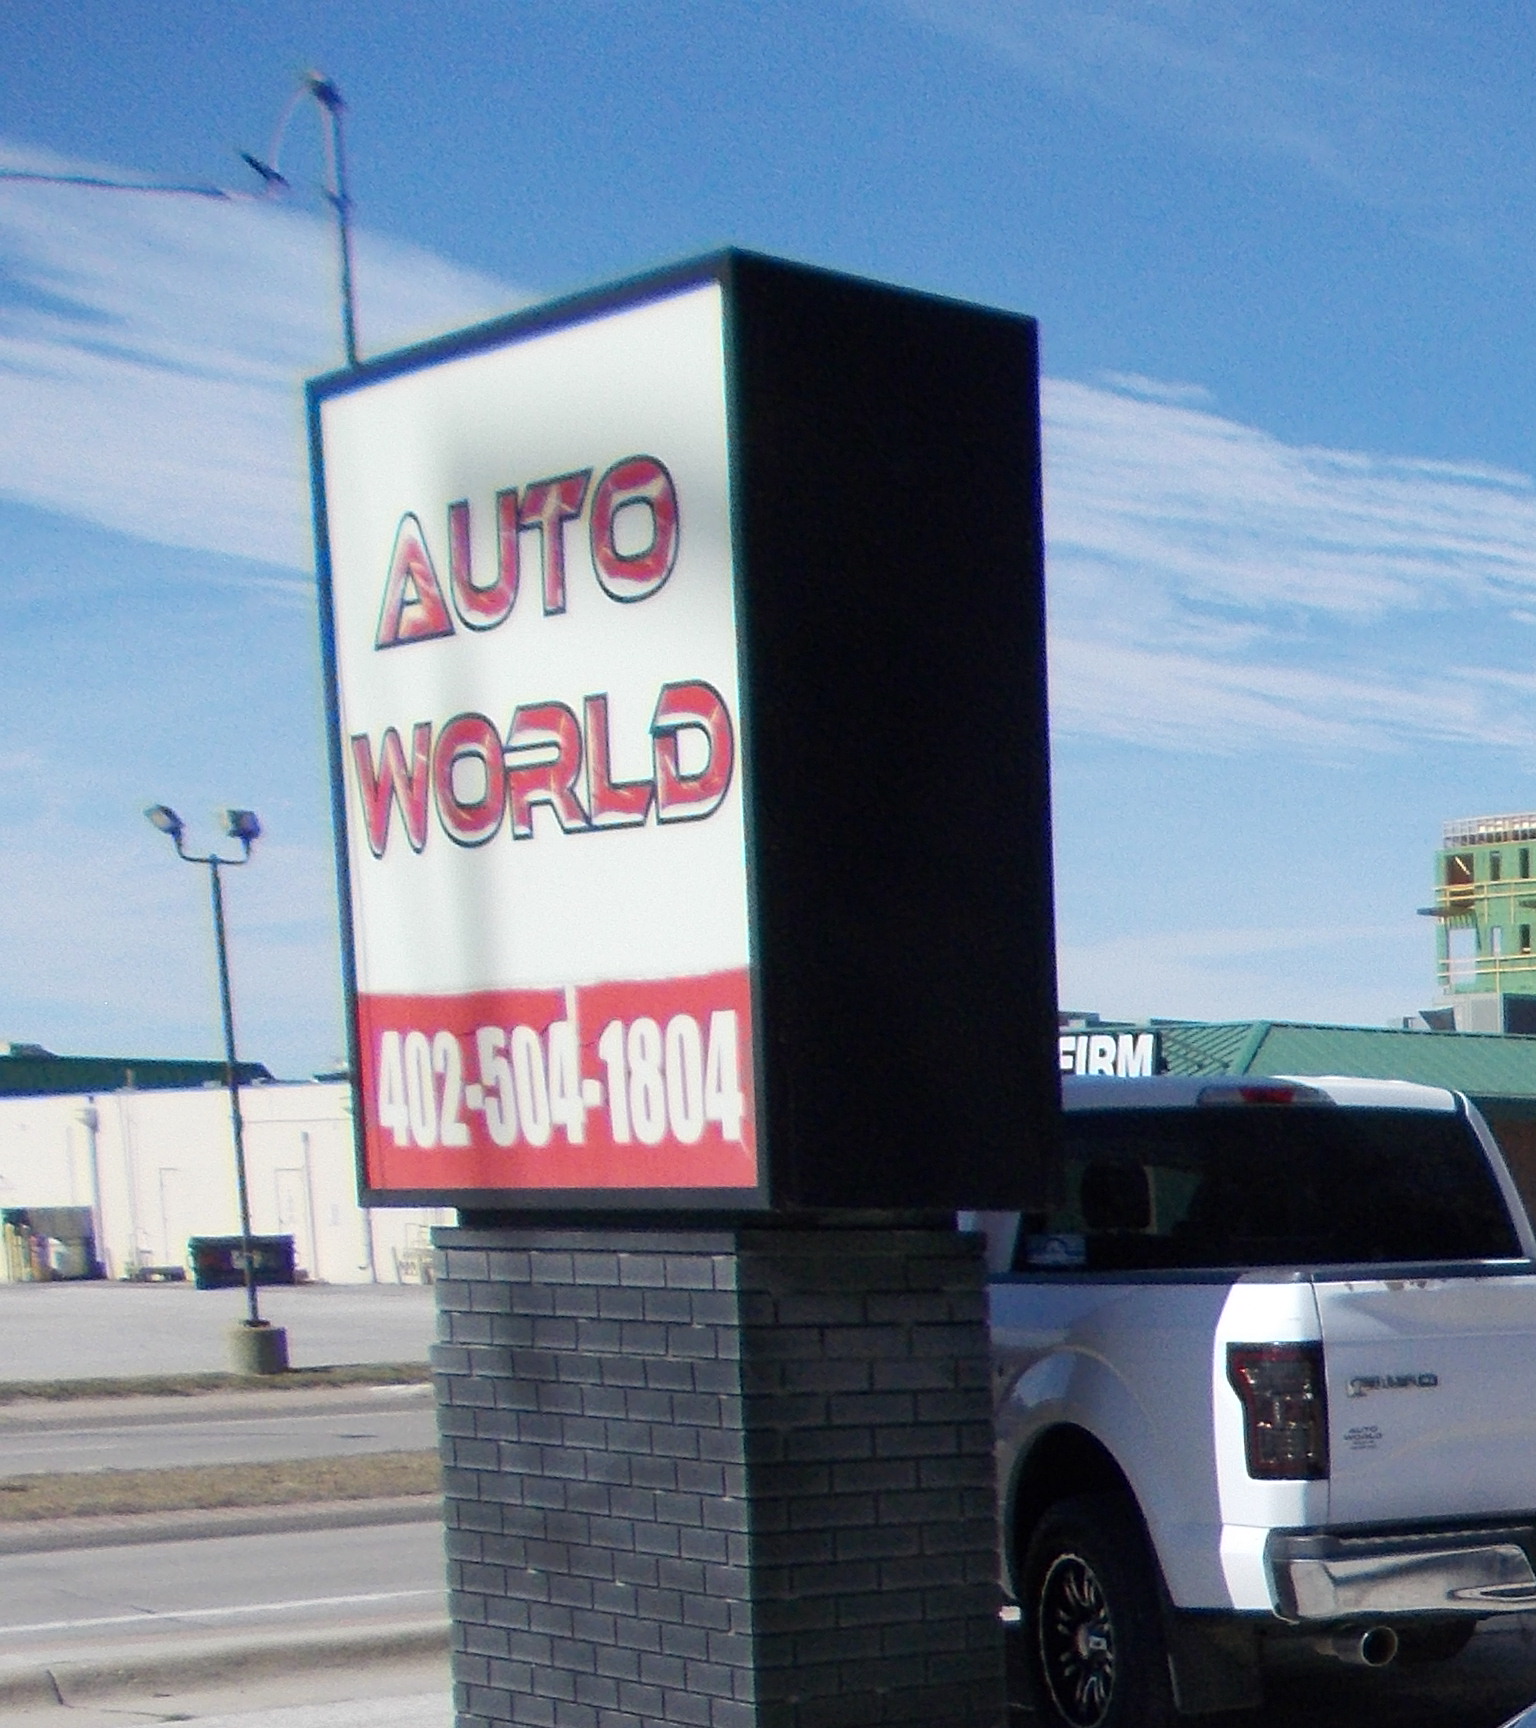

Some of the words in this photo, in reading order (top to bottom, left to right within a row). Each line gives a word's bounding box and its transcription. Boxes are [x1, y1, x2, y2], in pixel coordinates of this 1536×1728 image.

[375, 454, 681, 651] AUTO
[350, 679, 734, 860] WORLD
[378, 1009, 744, 1148] 402-504-1804
